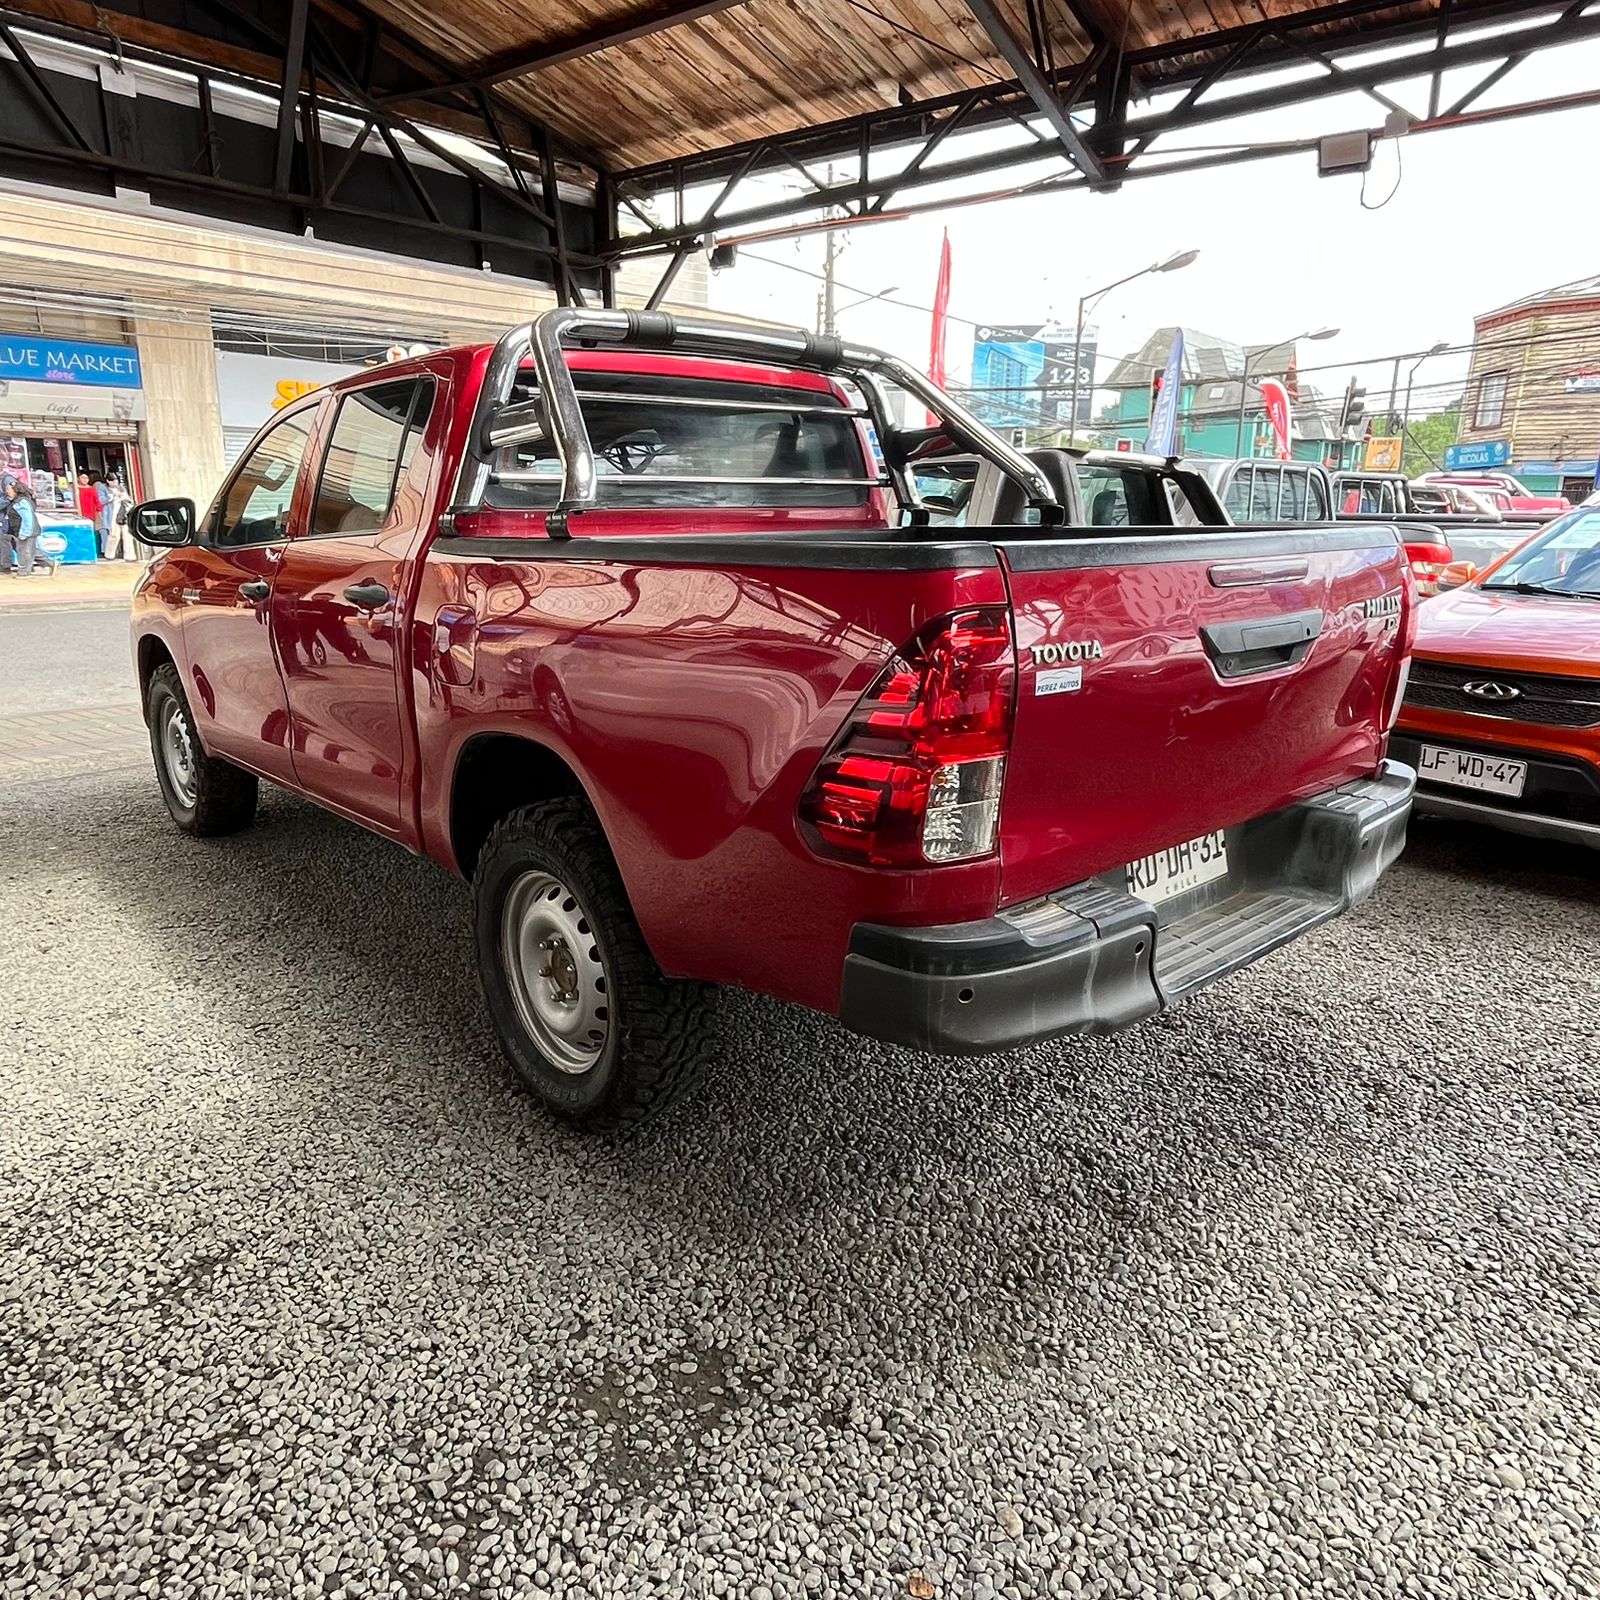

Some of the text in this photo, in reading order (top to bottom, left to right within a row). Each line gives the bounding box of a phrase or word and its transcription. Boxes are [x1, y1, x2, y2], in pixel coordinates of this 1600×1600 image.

[46, 351, 137, 374] MARKET
[1458, 452, 1489, 465] NICOLAS
[1030, 639, 1103, 665] TOYOTA
[1037, 680, 1079, 693] PEREZ AUTOS
[1451, 776, 1485, 788] CHILE
[1165, 874, 1198, 895] CHILE
